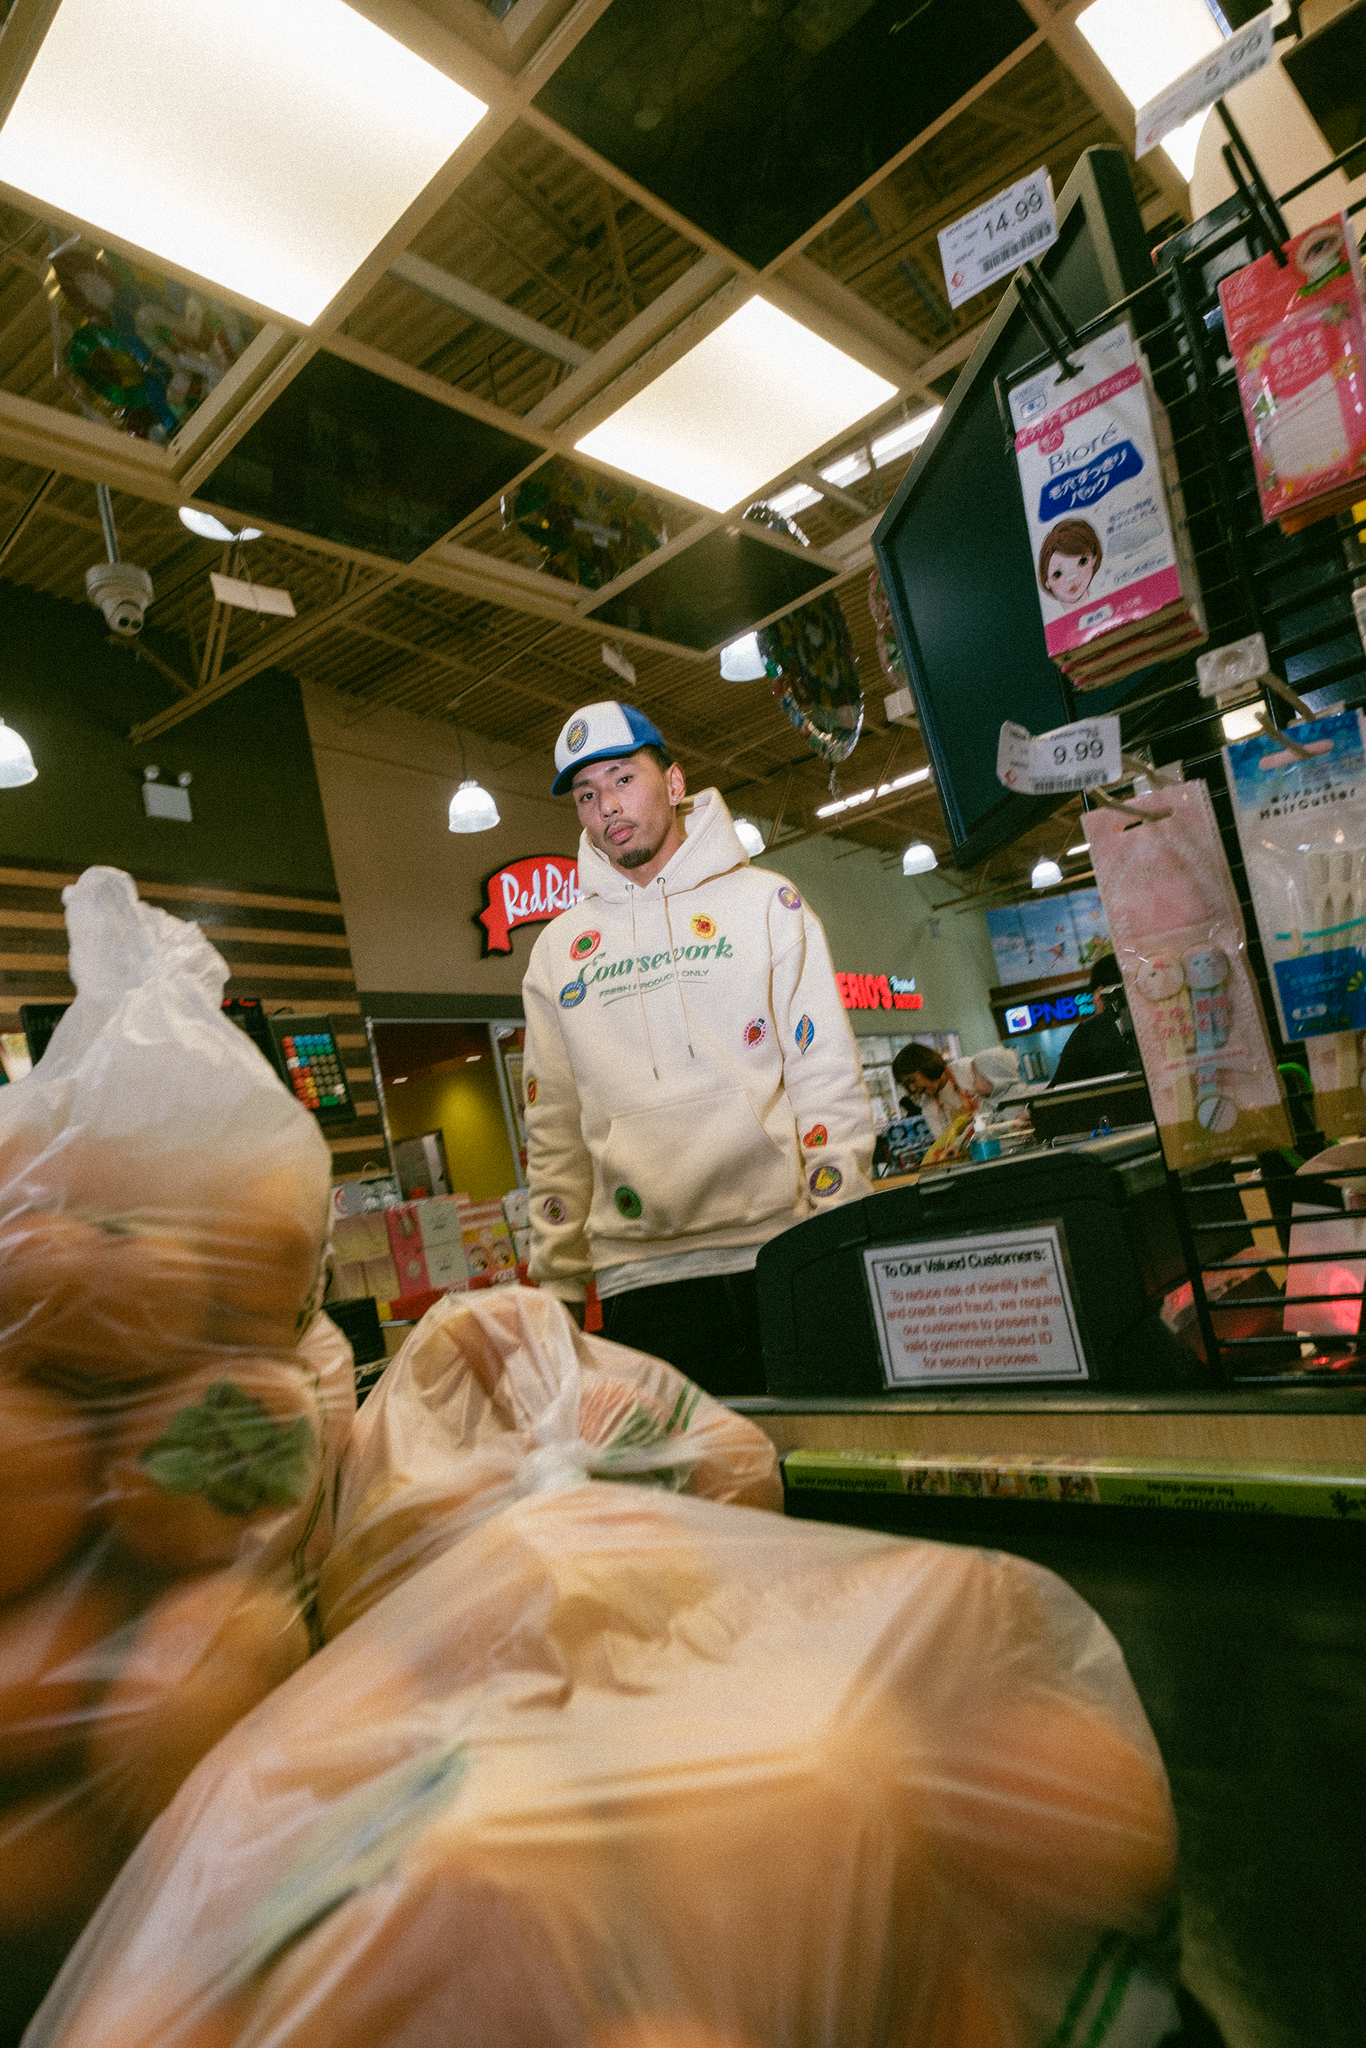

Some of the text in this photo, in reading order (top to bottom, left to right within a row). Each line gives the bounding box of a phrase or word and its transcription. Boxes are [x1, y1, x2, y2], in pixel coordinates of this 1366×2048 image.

[983, 192, 1043, 240] 14.99
[1048, 420, 1118, 475] Bioré
[1053, 739, 1104, 766] 9.99
[577, 936, 734, 987] Coursework
[599, 984, 632, 998] FRESH
[681, 969, 709, 978] ONLY
[1029, 996, 1078, 1028] PNB
[883, 1250, 1047, 1279] To Our Valued Customers:
[890, 1275, 1048, 1303] To reduce risk of identity theft
[887, 1307, 906, 1322] and
[908, 1304, 937, 1319] credit
[939, 1301, 963, 1316] card
[1000, 1299, 1017, 1311] we
[1020, 1294, 1062, 1311] require
[903, 1314, 1049, 1336] our customers to present a
[904, 1338, 928, 1353] valid
[1038, 1330, 1053, 1345] ID
[923, 1356, 937, 1369] for
[940, 1354, 981, 1370] security
